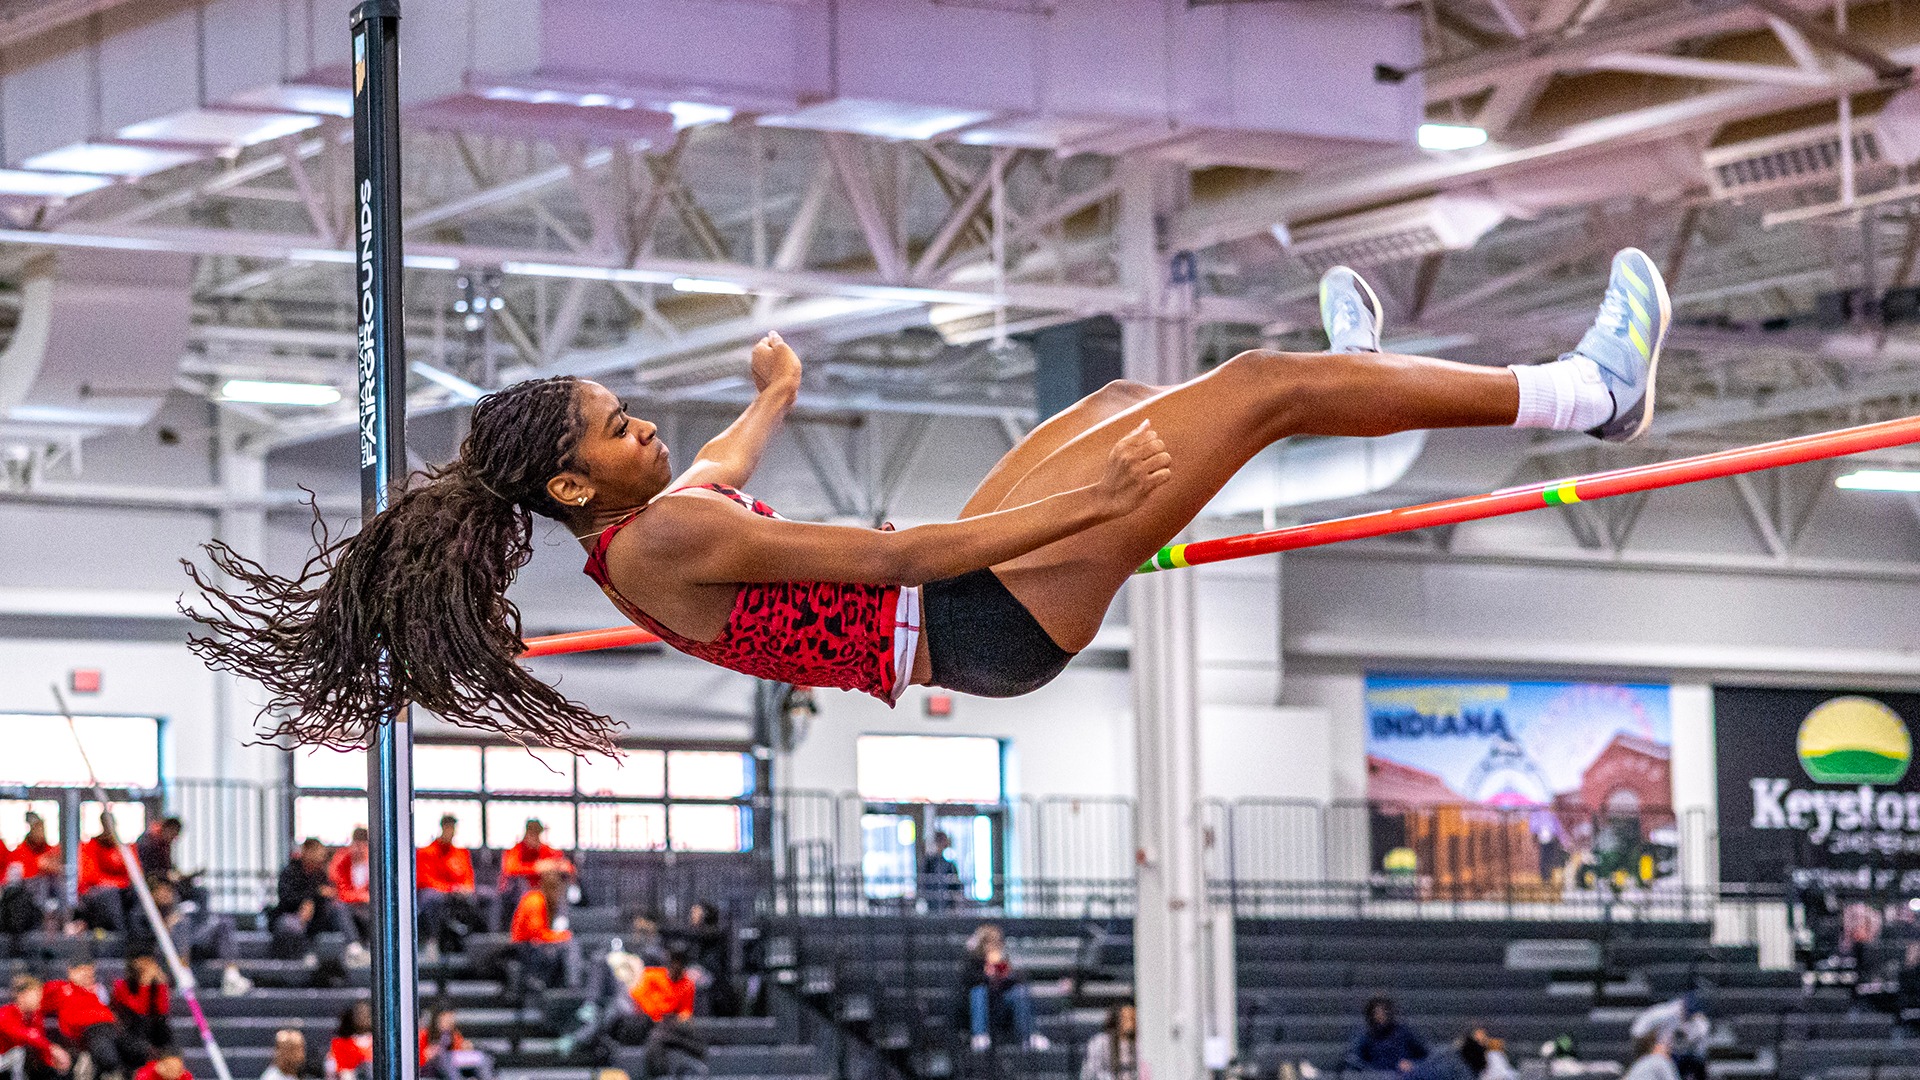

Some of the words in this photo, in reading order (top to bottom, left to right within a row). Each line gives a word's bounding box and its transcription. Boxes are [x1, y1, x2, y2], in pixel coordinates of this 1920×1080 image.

[358, 324, 366, 384] STATE
[360, 178, 377, 467] FAIRGROUNDS
[359, 387, 368, 469] INDIANA
[1372, 708, 1516, 742] INDIANA
